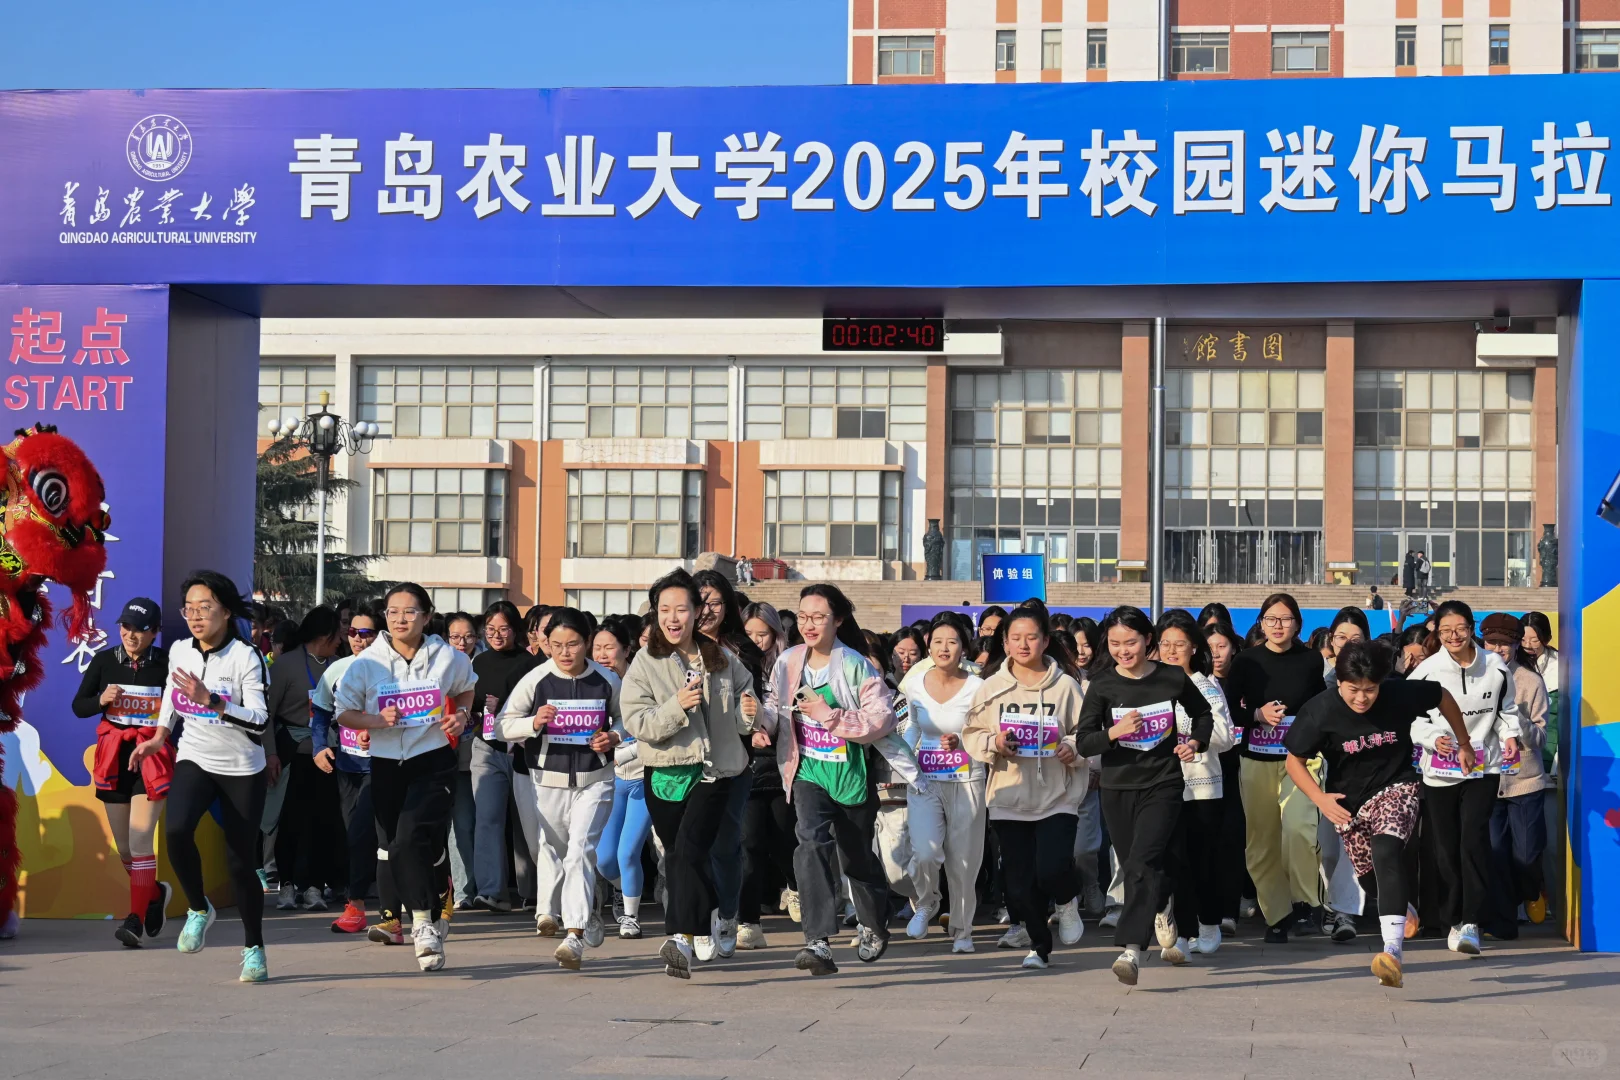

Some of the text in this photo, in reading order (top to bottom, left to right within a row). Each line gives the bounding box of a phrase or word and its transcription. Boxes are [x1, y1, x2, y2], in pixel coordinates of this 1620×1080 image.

[288, 121, 1612, 222] 青岛农业大学2025年校园迷你马拉
[59, 231, 258, 244] QINGDAO AGRICULTURAL UNIVERSITY
[9, 306, 131, 366] 起点
[832, 324, 935, 347] 00:02:40
[3, 374, 133, 411] START
[992, 567, 1034, 580] 体验组
[385, 693, 435, 710] C0003
[554, 713, 600, 727] C0004
[1134, 717, 1168, 734] 198
[1252, 728, 1289, 740] C007
[922, 752, 963, 765] C0226
